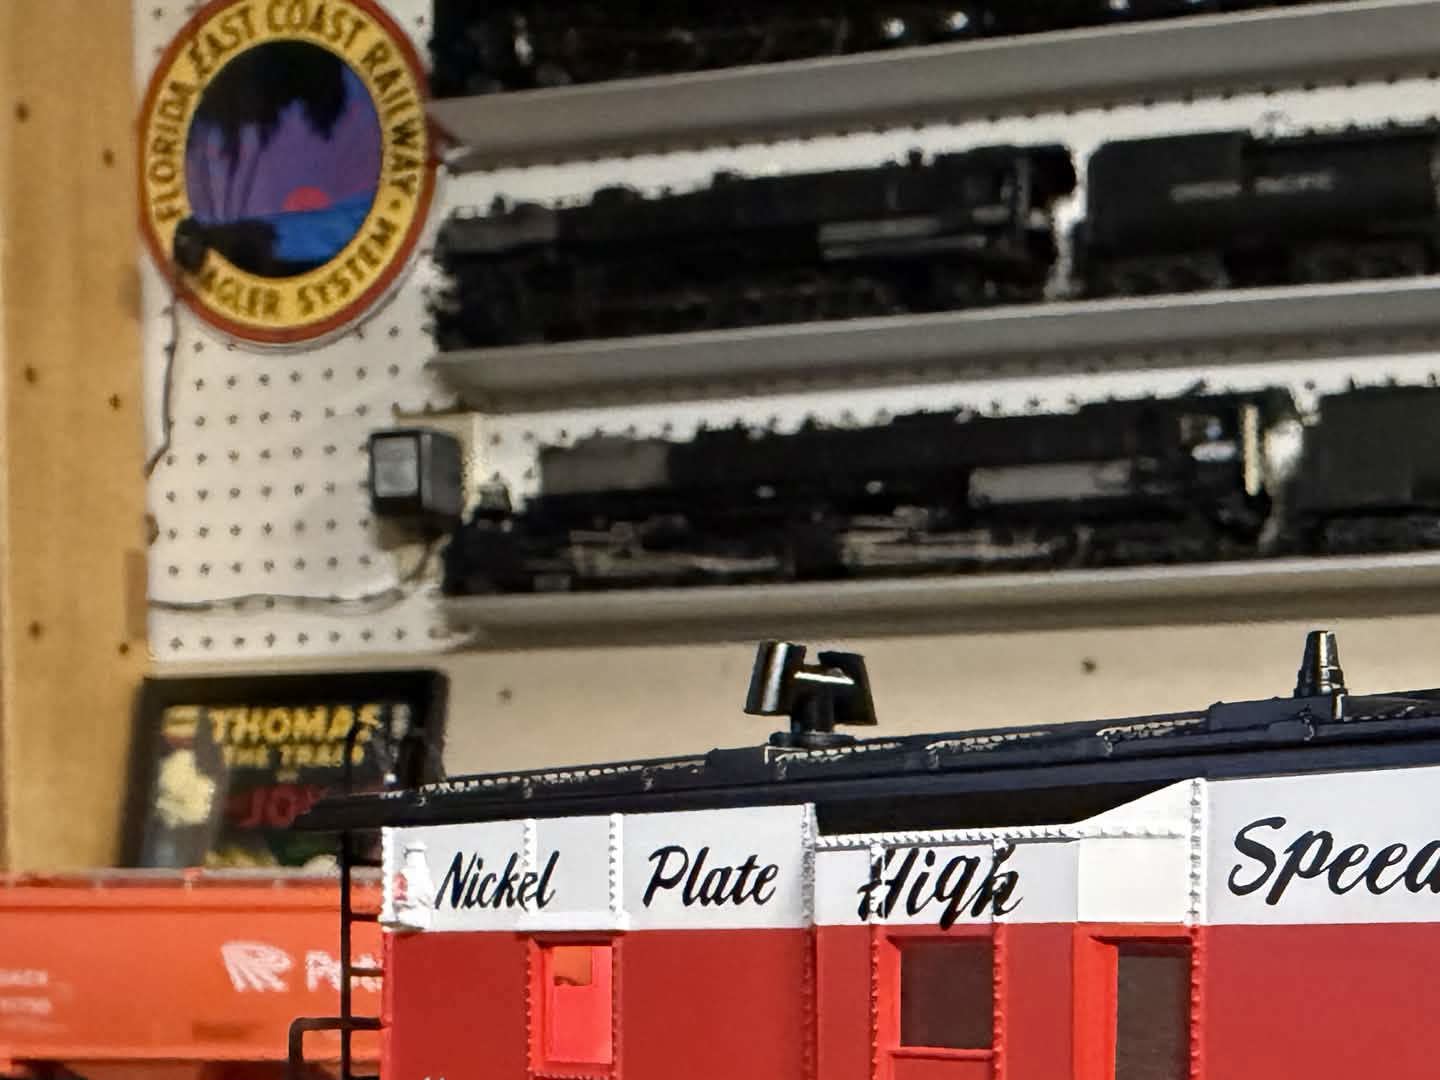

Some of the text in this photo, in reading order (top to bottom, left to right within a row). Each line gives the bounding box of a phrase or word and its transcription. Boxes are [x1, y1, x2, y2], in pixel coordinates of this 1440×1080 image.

[149, 0, 418, 222] FLORIDA EAST COAST RAILWAY
[296, 216, 398, 315] SYSTEM
[435, 850, 560, 909] Nickel
[642, 845, 780, 908] Plate
[857, 842, 1024, 930] High
